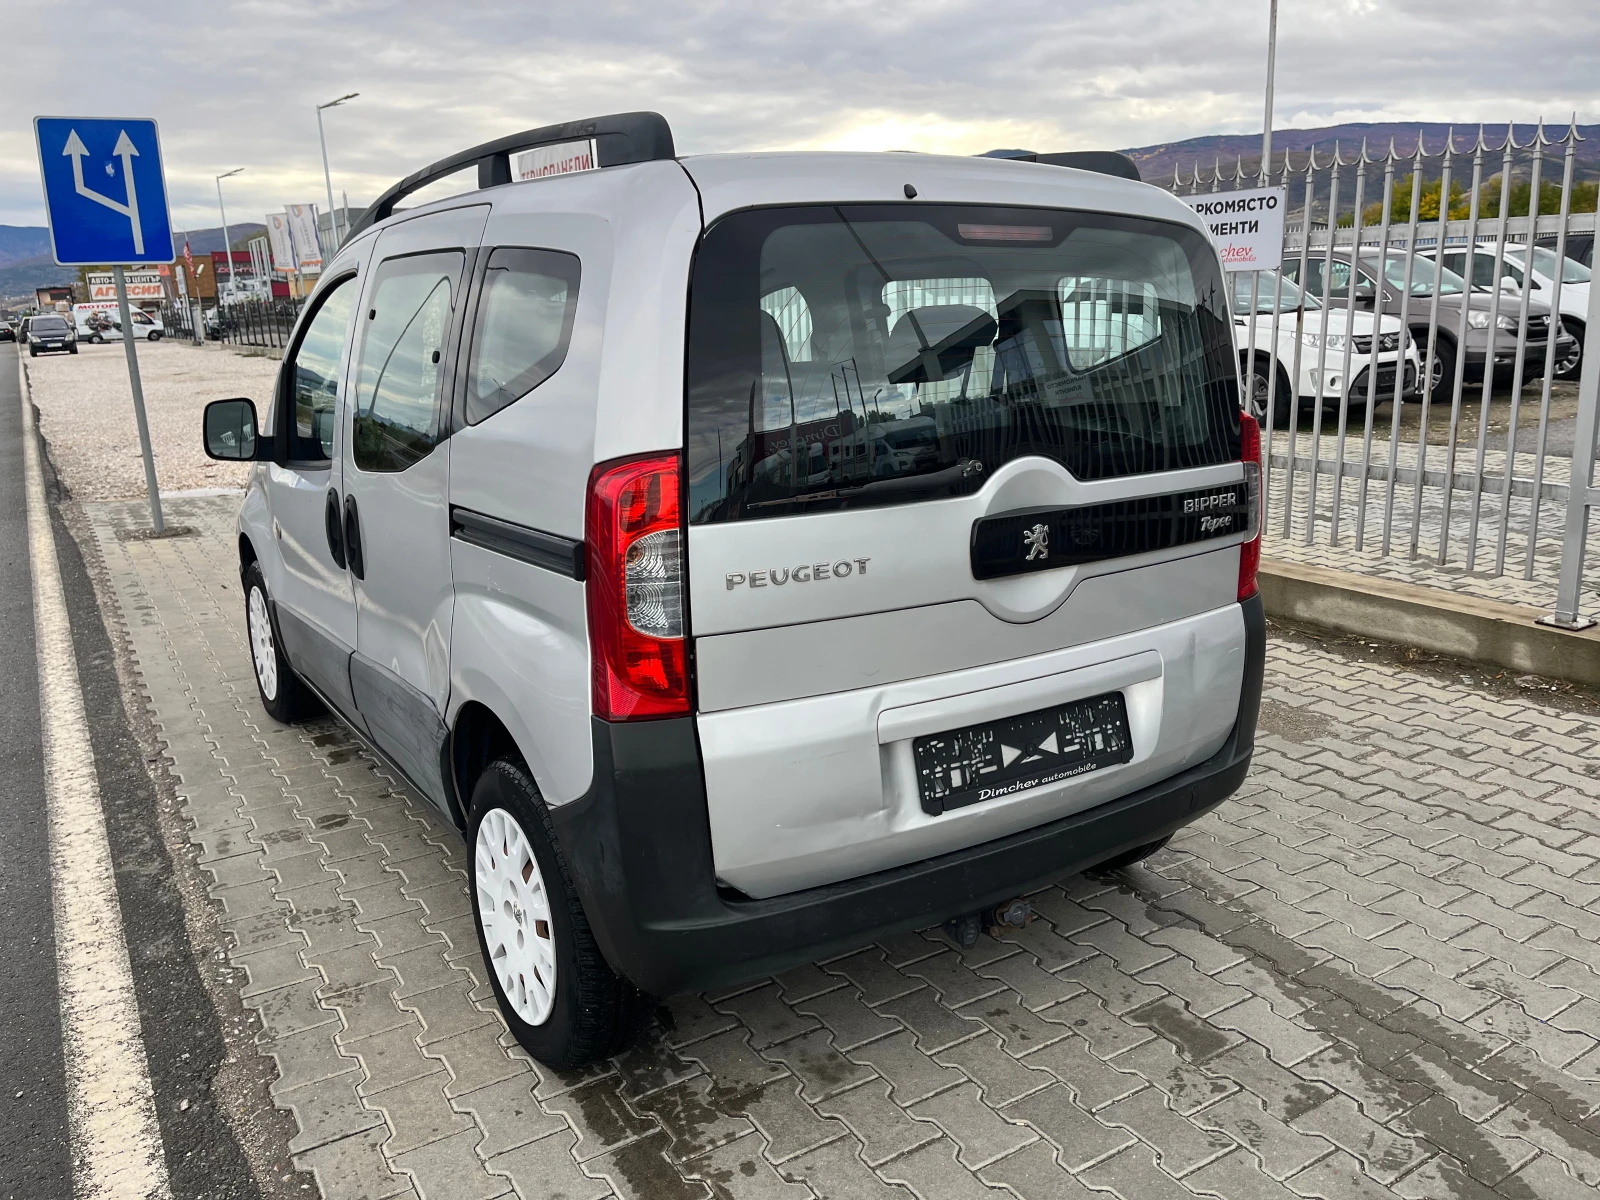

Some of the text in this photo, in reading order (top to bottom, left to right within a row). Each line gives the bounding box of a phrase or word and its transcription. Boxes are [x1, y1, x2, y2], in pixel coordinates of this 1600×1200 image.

[1209, 220, 1259, 236] ИЕНТИ
[1219, 242, 1253, 258] chev
[1221, 254, 1257, 263] utomobile
[1183, 492, 1237, 514] BIPPER
[1200, 515, 1232, 533] Tepee
[725, 556, 871, 591] PEUGEOT
[978, 762, 1097, 801] Dimchev automobile
